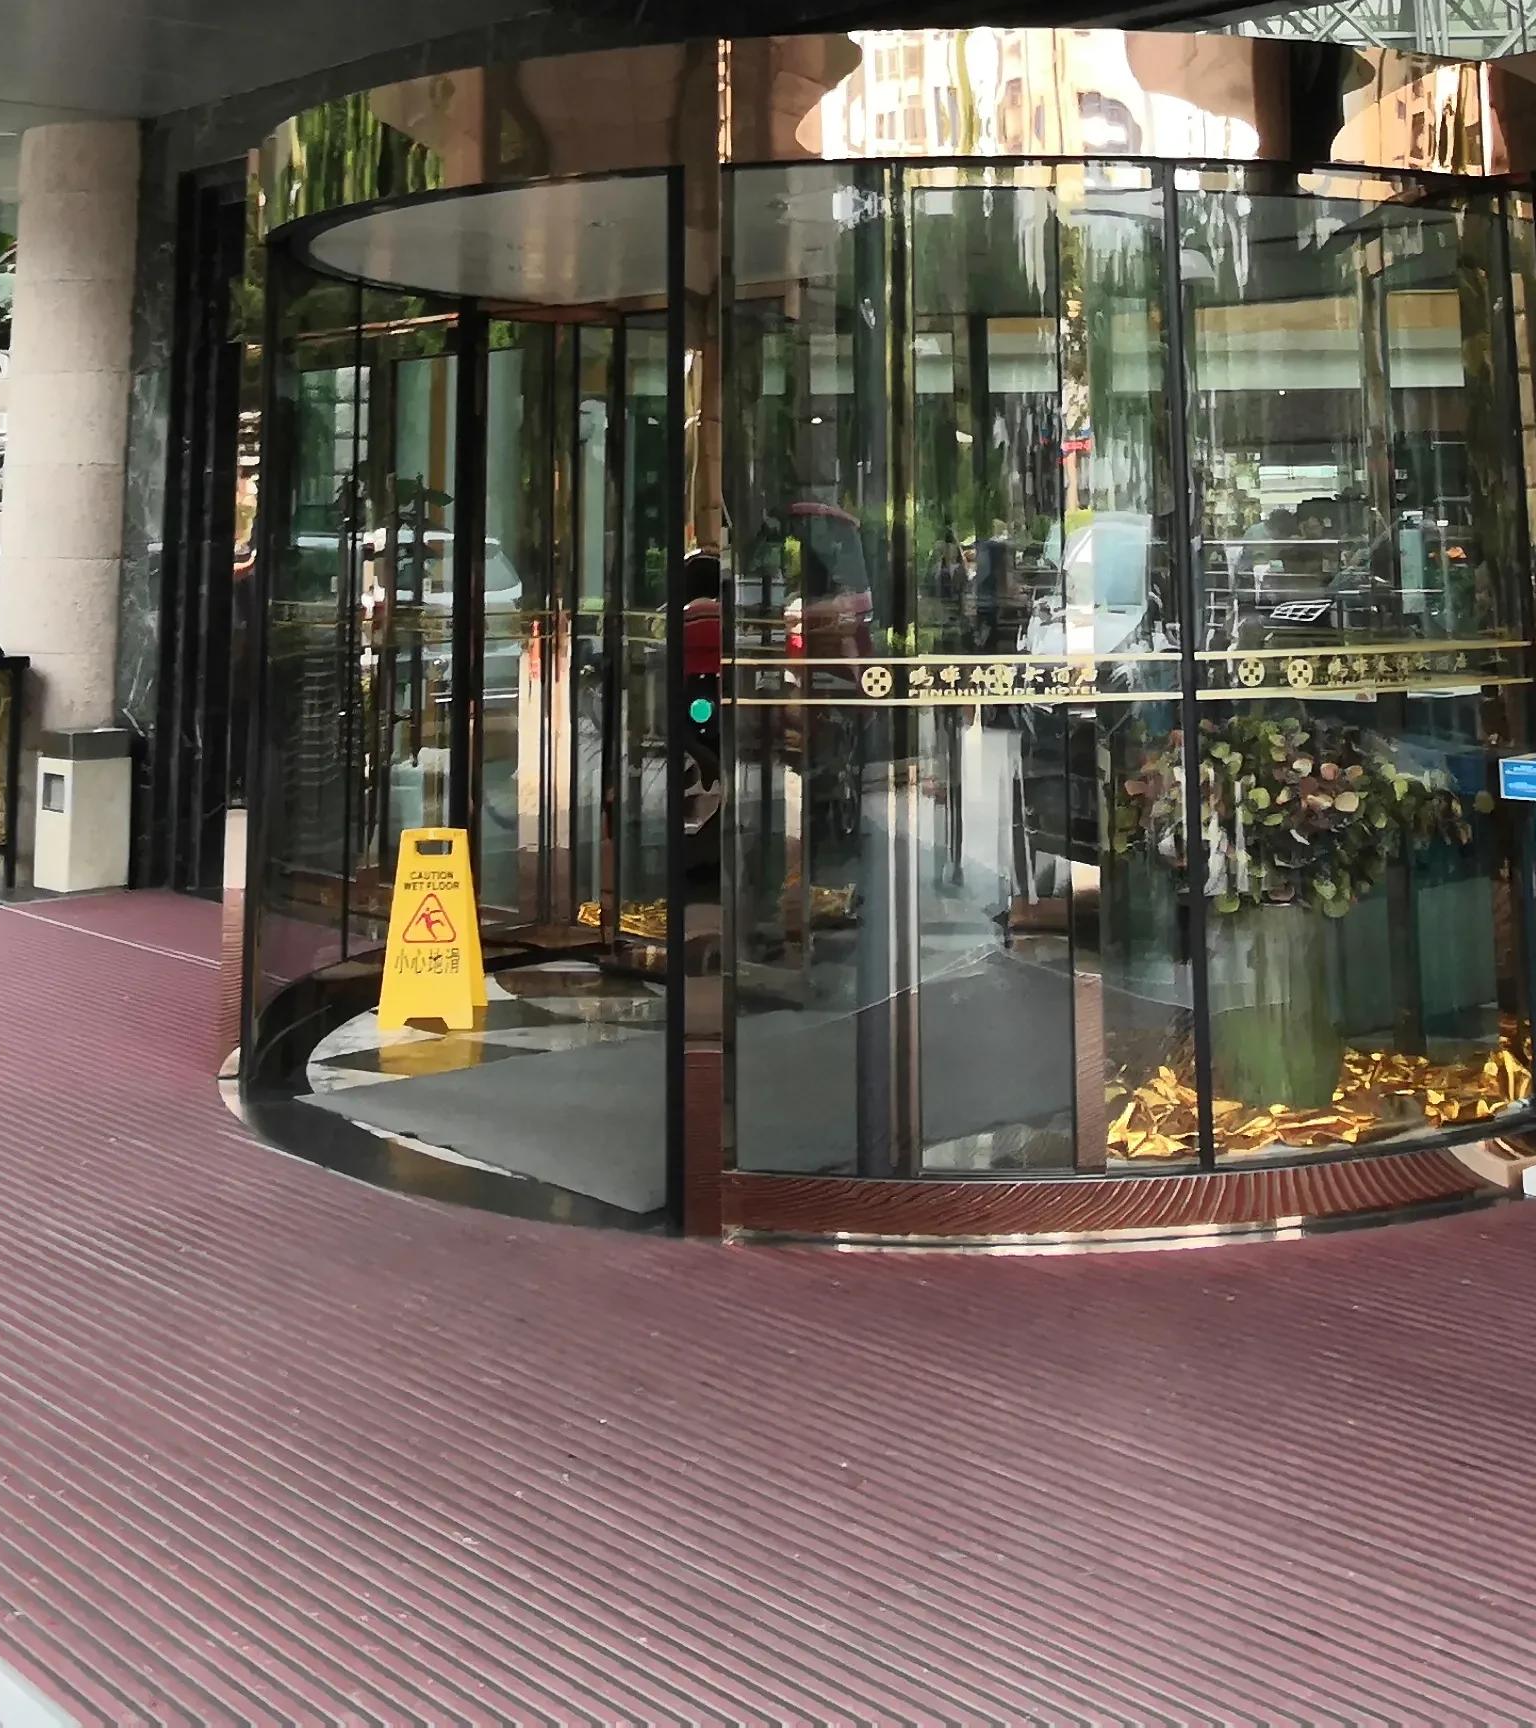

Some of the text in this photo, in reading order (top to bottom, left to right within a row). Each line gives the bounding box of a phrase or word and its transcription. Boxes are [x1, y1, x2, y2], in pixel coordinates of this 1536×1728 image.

[409, 871, 454, 880] CAUTION
[404, 881, 460, 891] WET FLOOR
[394, 947, 460, 974] 小心地滑
